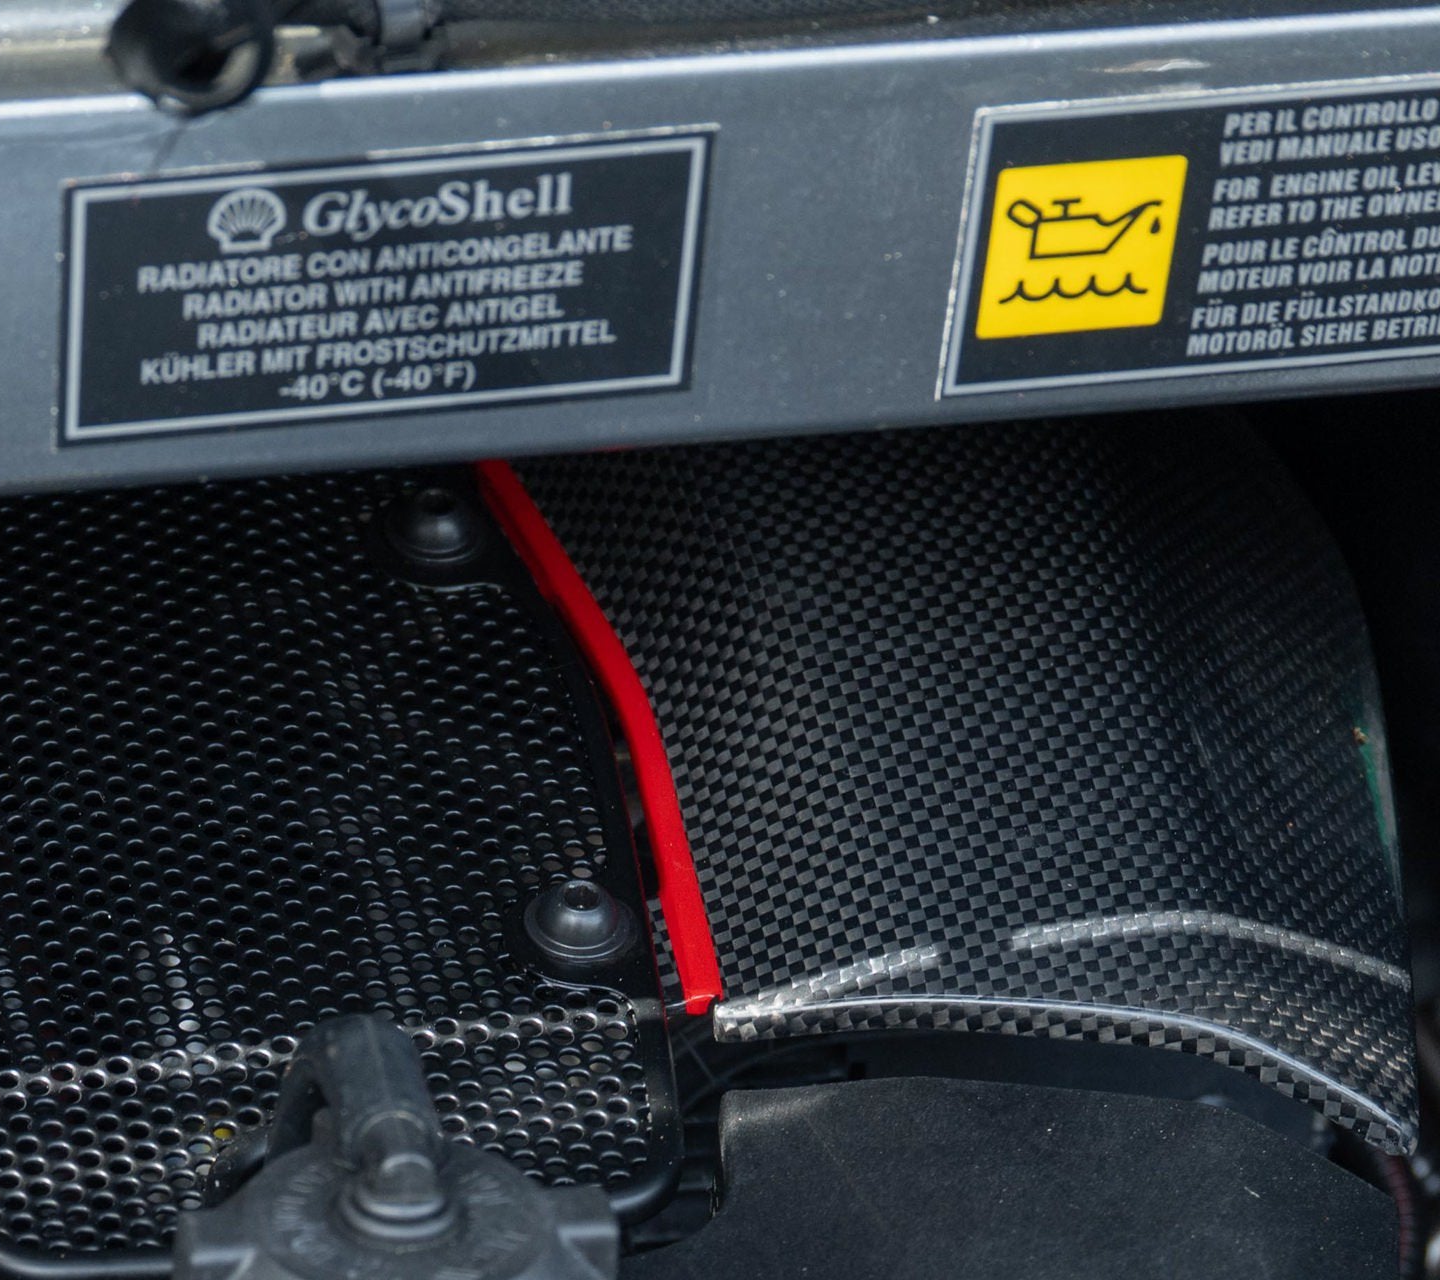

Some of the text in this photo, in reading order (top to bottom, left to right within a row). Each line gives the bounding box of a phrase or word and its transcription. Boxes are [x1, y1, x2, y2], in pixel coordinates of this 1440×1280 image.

[1224, 109, 1272, 138] PER
[1274, 107, 1298, 133] IL
[1301, 96, 1438, 130] CONTROLLO
[1219, 138, 1272, 166] VEDI
[1276, 129, 1392, 161] MANUALE
[1212, 176, 1259, 201] FOR
[1270, 167, 1358, 197] ENGINE
[1362, 164, 1399, 189] OIL
[302, 172, 573, 241] GlycoShell
[1208, 202, 1284, 231] REFER
[1287, 200, 1318, 225] TO
[1322, 195, 1364, 221] THE
[138, 226, 633, 292] RADIATORE CON ANTICONGELANTE
[1201, 239, 1267, 267] POUR
[1270, 237, 1299, 260] LE
[183, 261, 584, 320] RADIATOR WITH ANTIFREEZE
[1197, 263, 1294, 294] MOTEUR
[1298, 259, 1352, 286] VOIR
[1355, 256, 1387, 280] LA
[197, 295, 566, 349] RADIATEUR AVEC ANTIGEL
[1191, 298, 1237, 330] FÜR
[1241, 301, 1280, 325] DIE
[141, 320, 617, 385] KÜHLER MIT FROSTSCHUTZMITTEL
[1186, 322, 1296, 357] MOTORÖL
[1300, 319, 1368, 347] SIEHE
